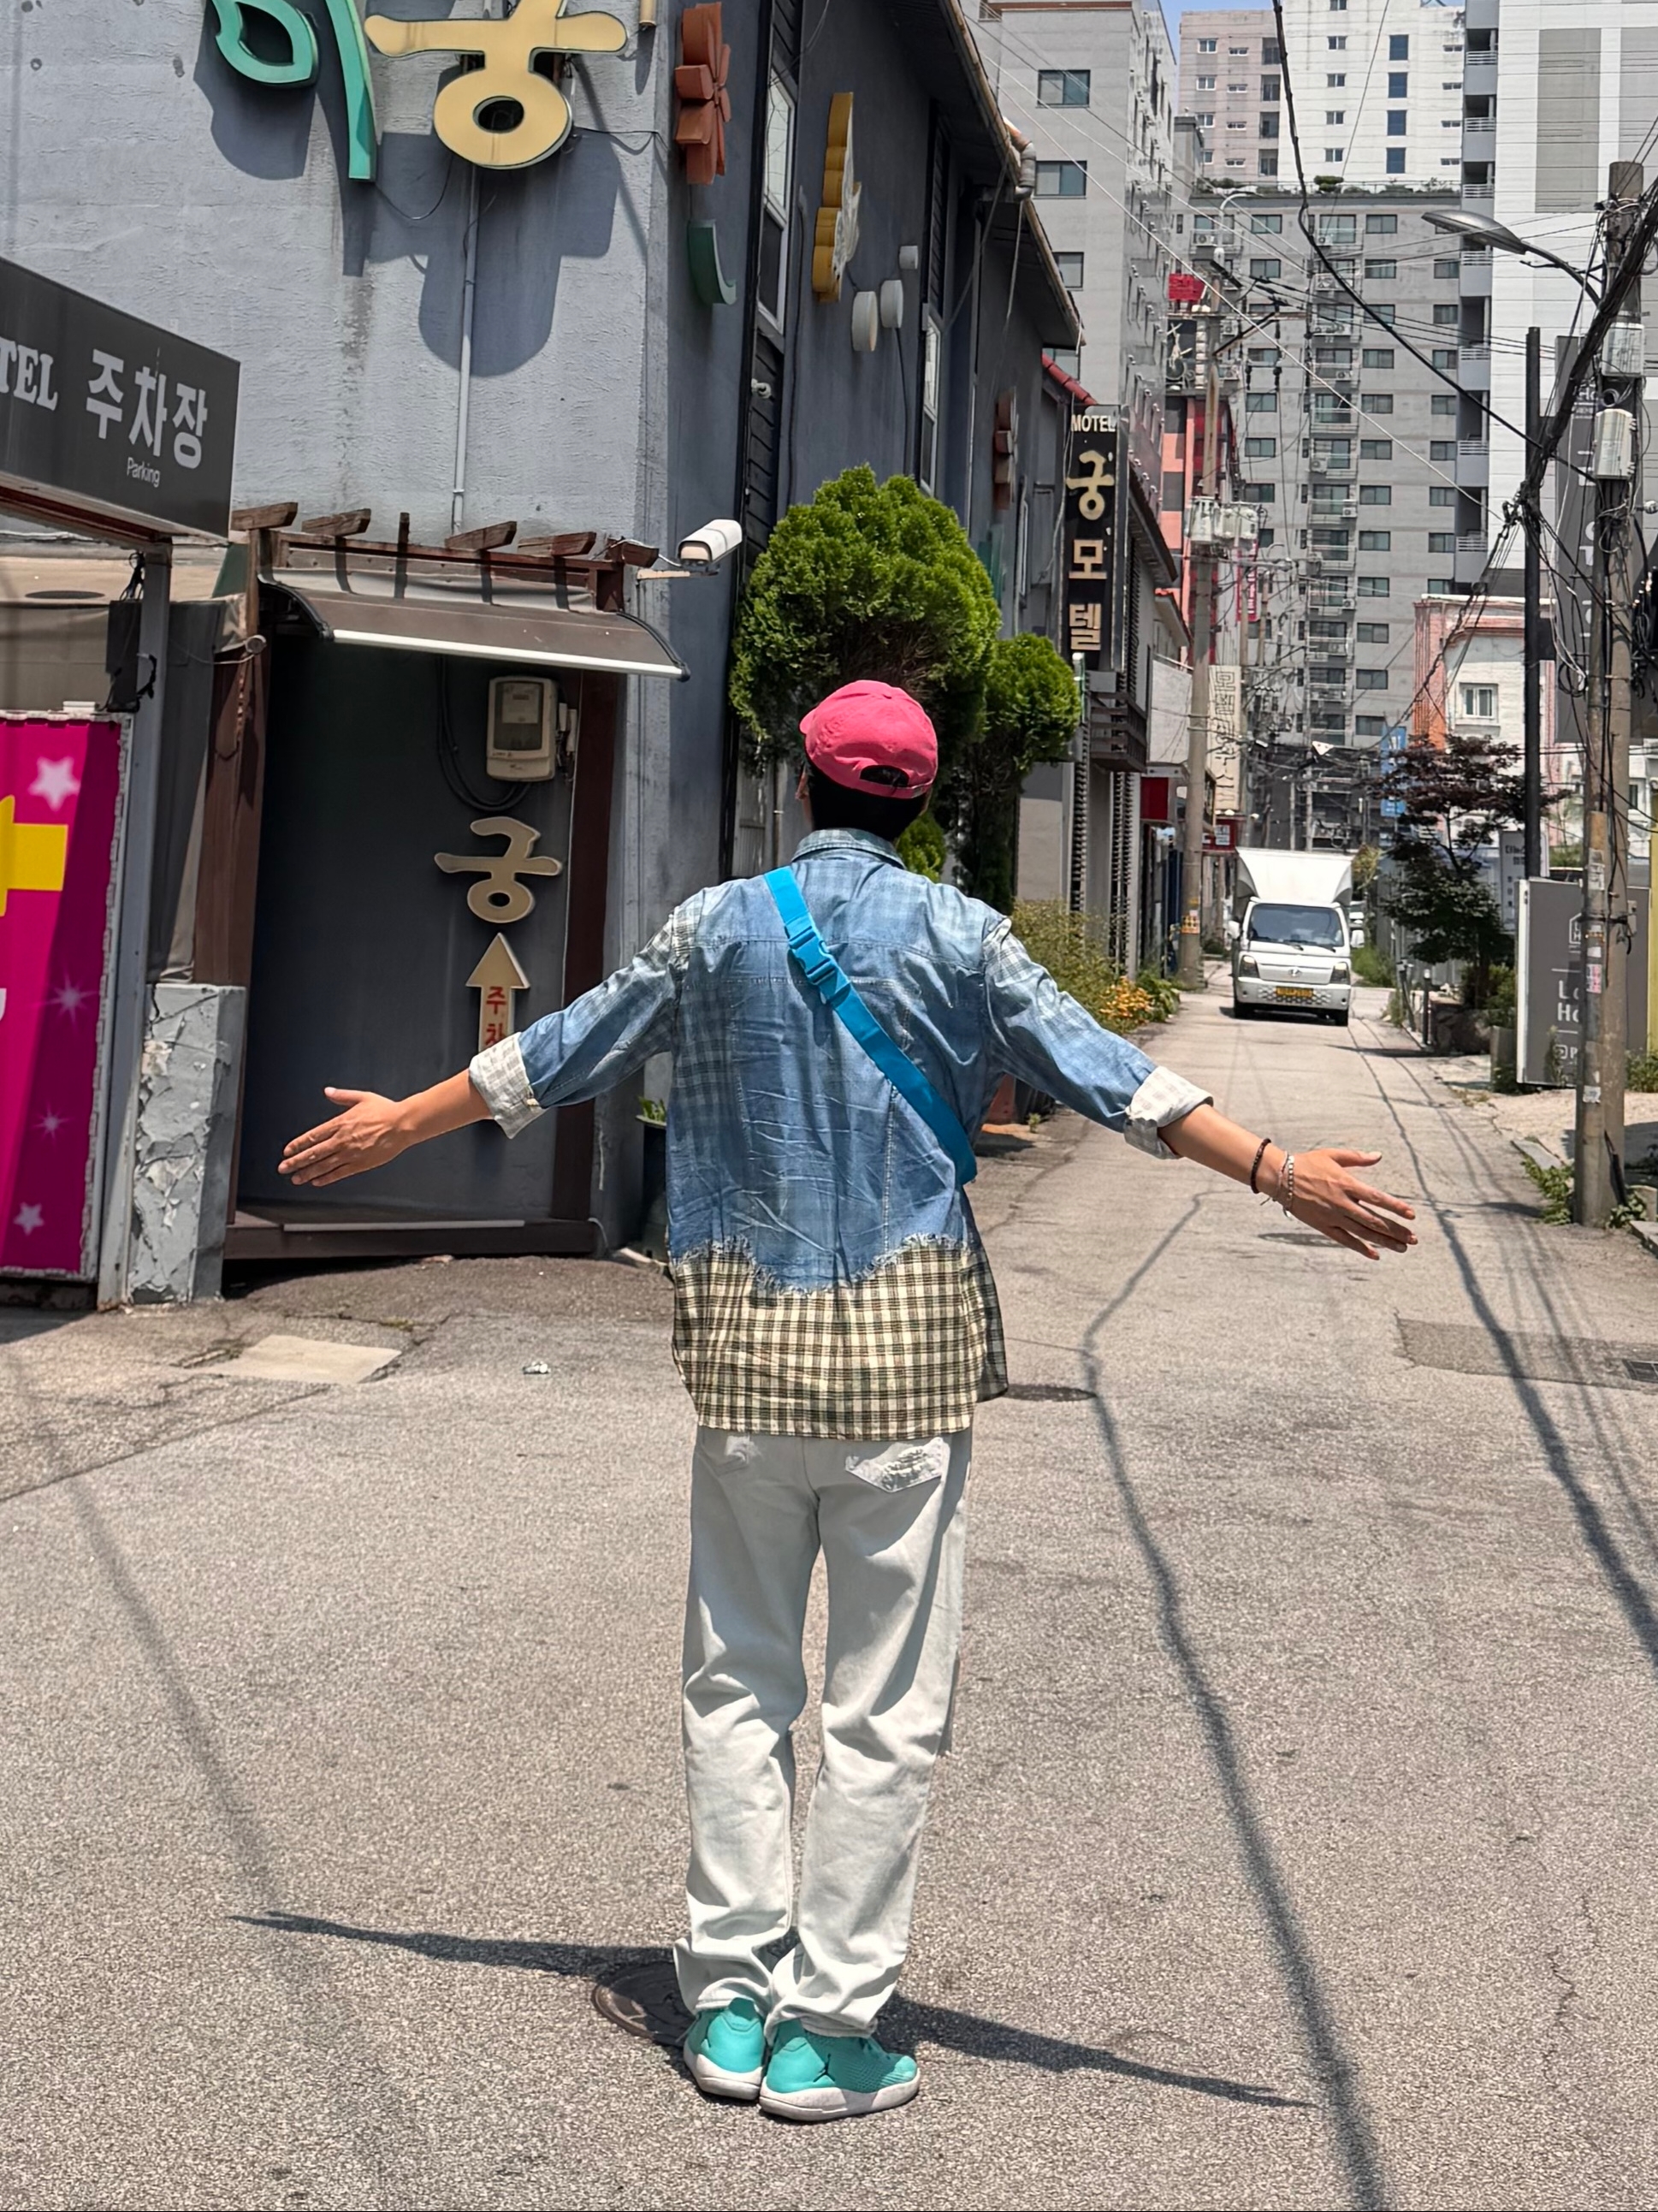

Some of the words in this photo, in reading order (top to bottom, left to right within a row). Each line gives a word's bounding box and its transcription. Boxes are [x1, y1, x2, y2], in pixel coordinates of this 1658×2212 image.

[86, 348, 208, 469] 주차장
[1070, 414, 1116, 432] MOTEL
[127, 456, 161, 488] Parking
[1069, 539, 1108, 650] 모텔
[434, 816, 562, 923] 궁
